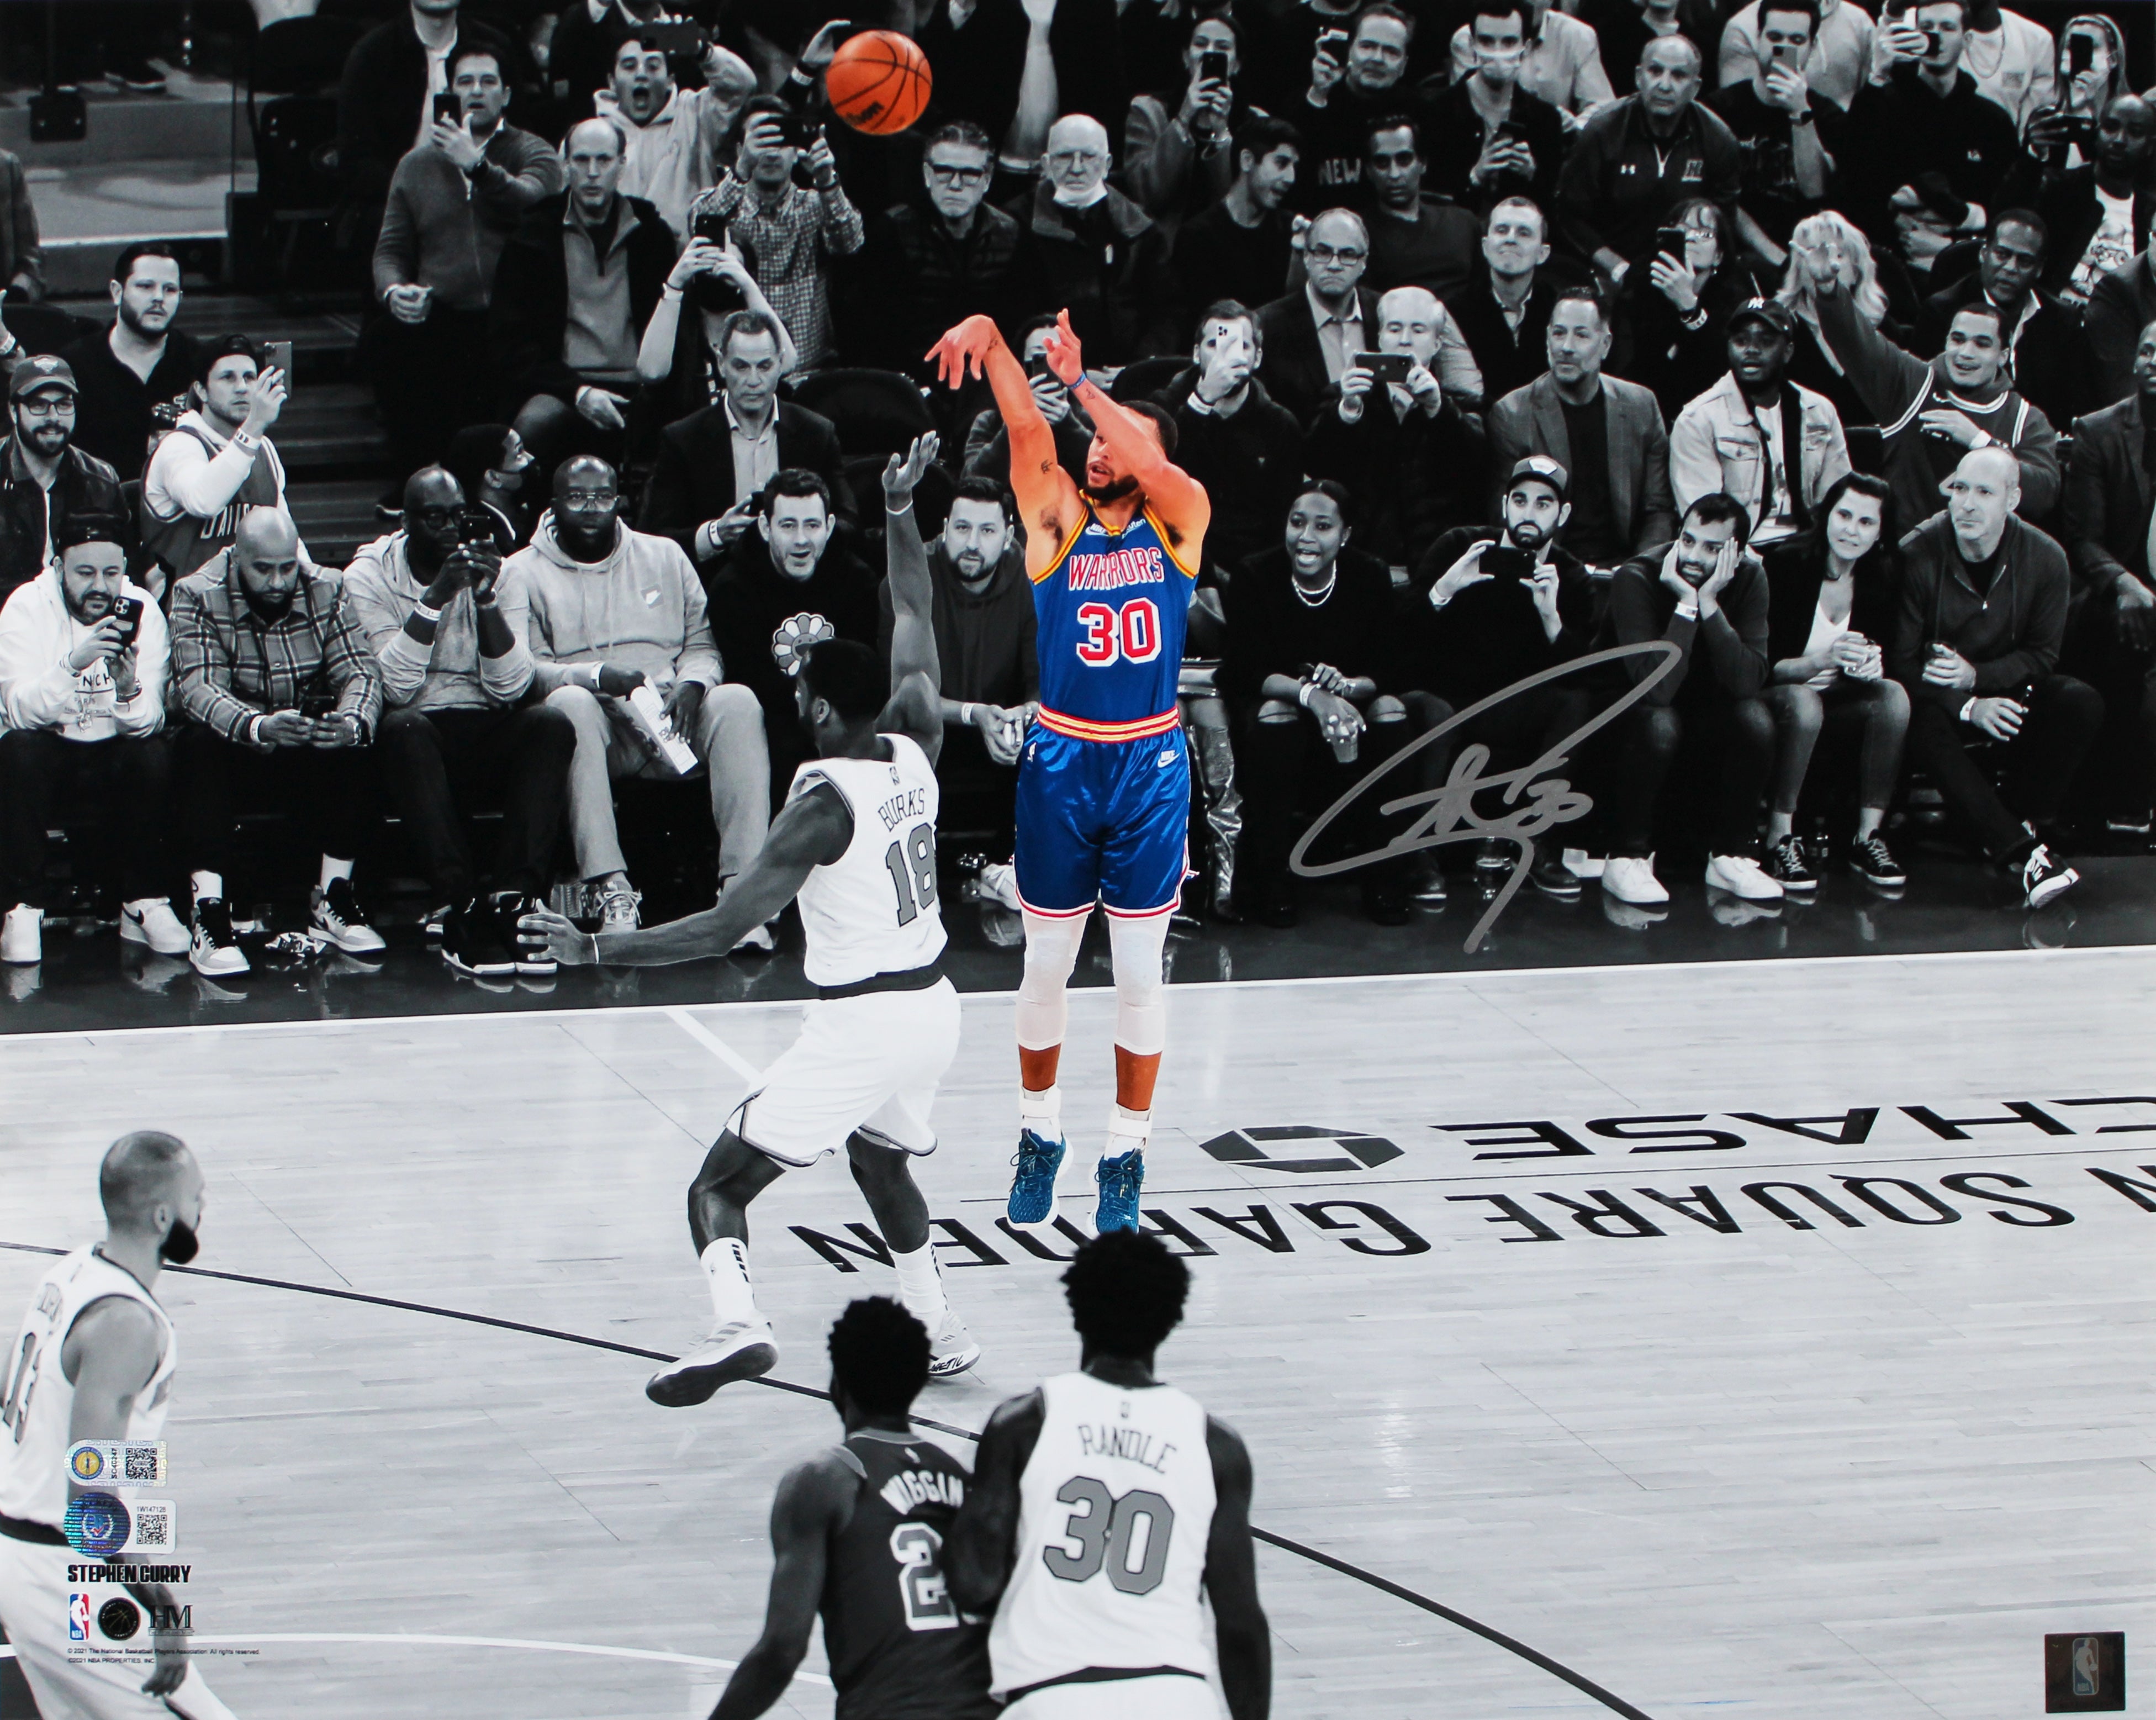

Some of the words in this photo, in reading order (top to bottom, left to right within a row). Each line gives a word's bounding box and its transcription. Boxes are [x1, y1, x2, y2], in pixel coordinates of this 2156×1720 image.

[1317, 157, 1361, 185] NEW
[1076, 597, 1162, 667] 30
[877, 788, 925, 833] BURKS
[885, 822, 937, 928] 18
[1445, 1172, 2075, 1243] SQUARE
[1078, 1424, 1177, 1475] RANDLE
[879, 1469, 965, 1516] WIGGIN
[1043, 1475, 1175, 1596] 30
[889, 1521, 960, 1632] 2
